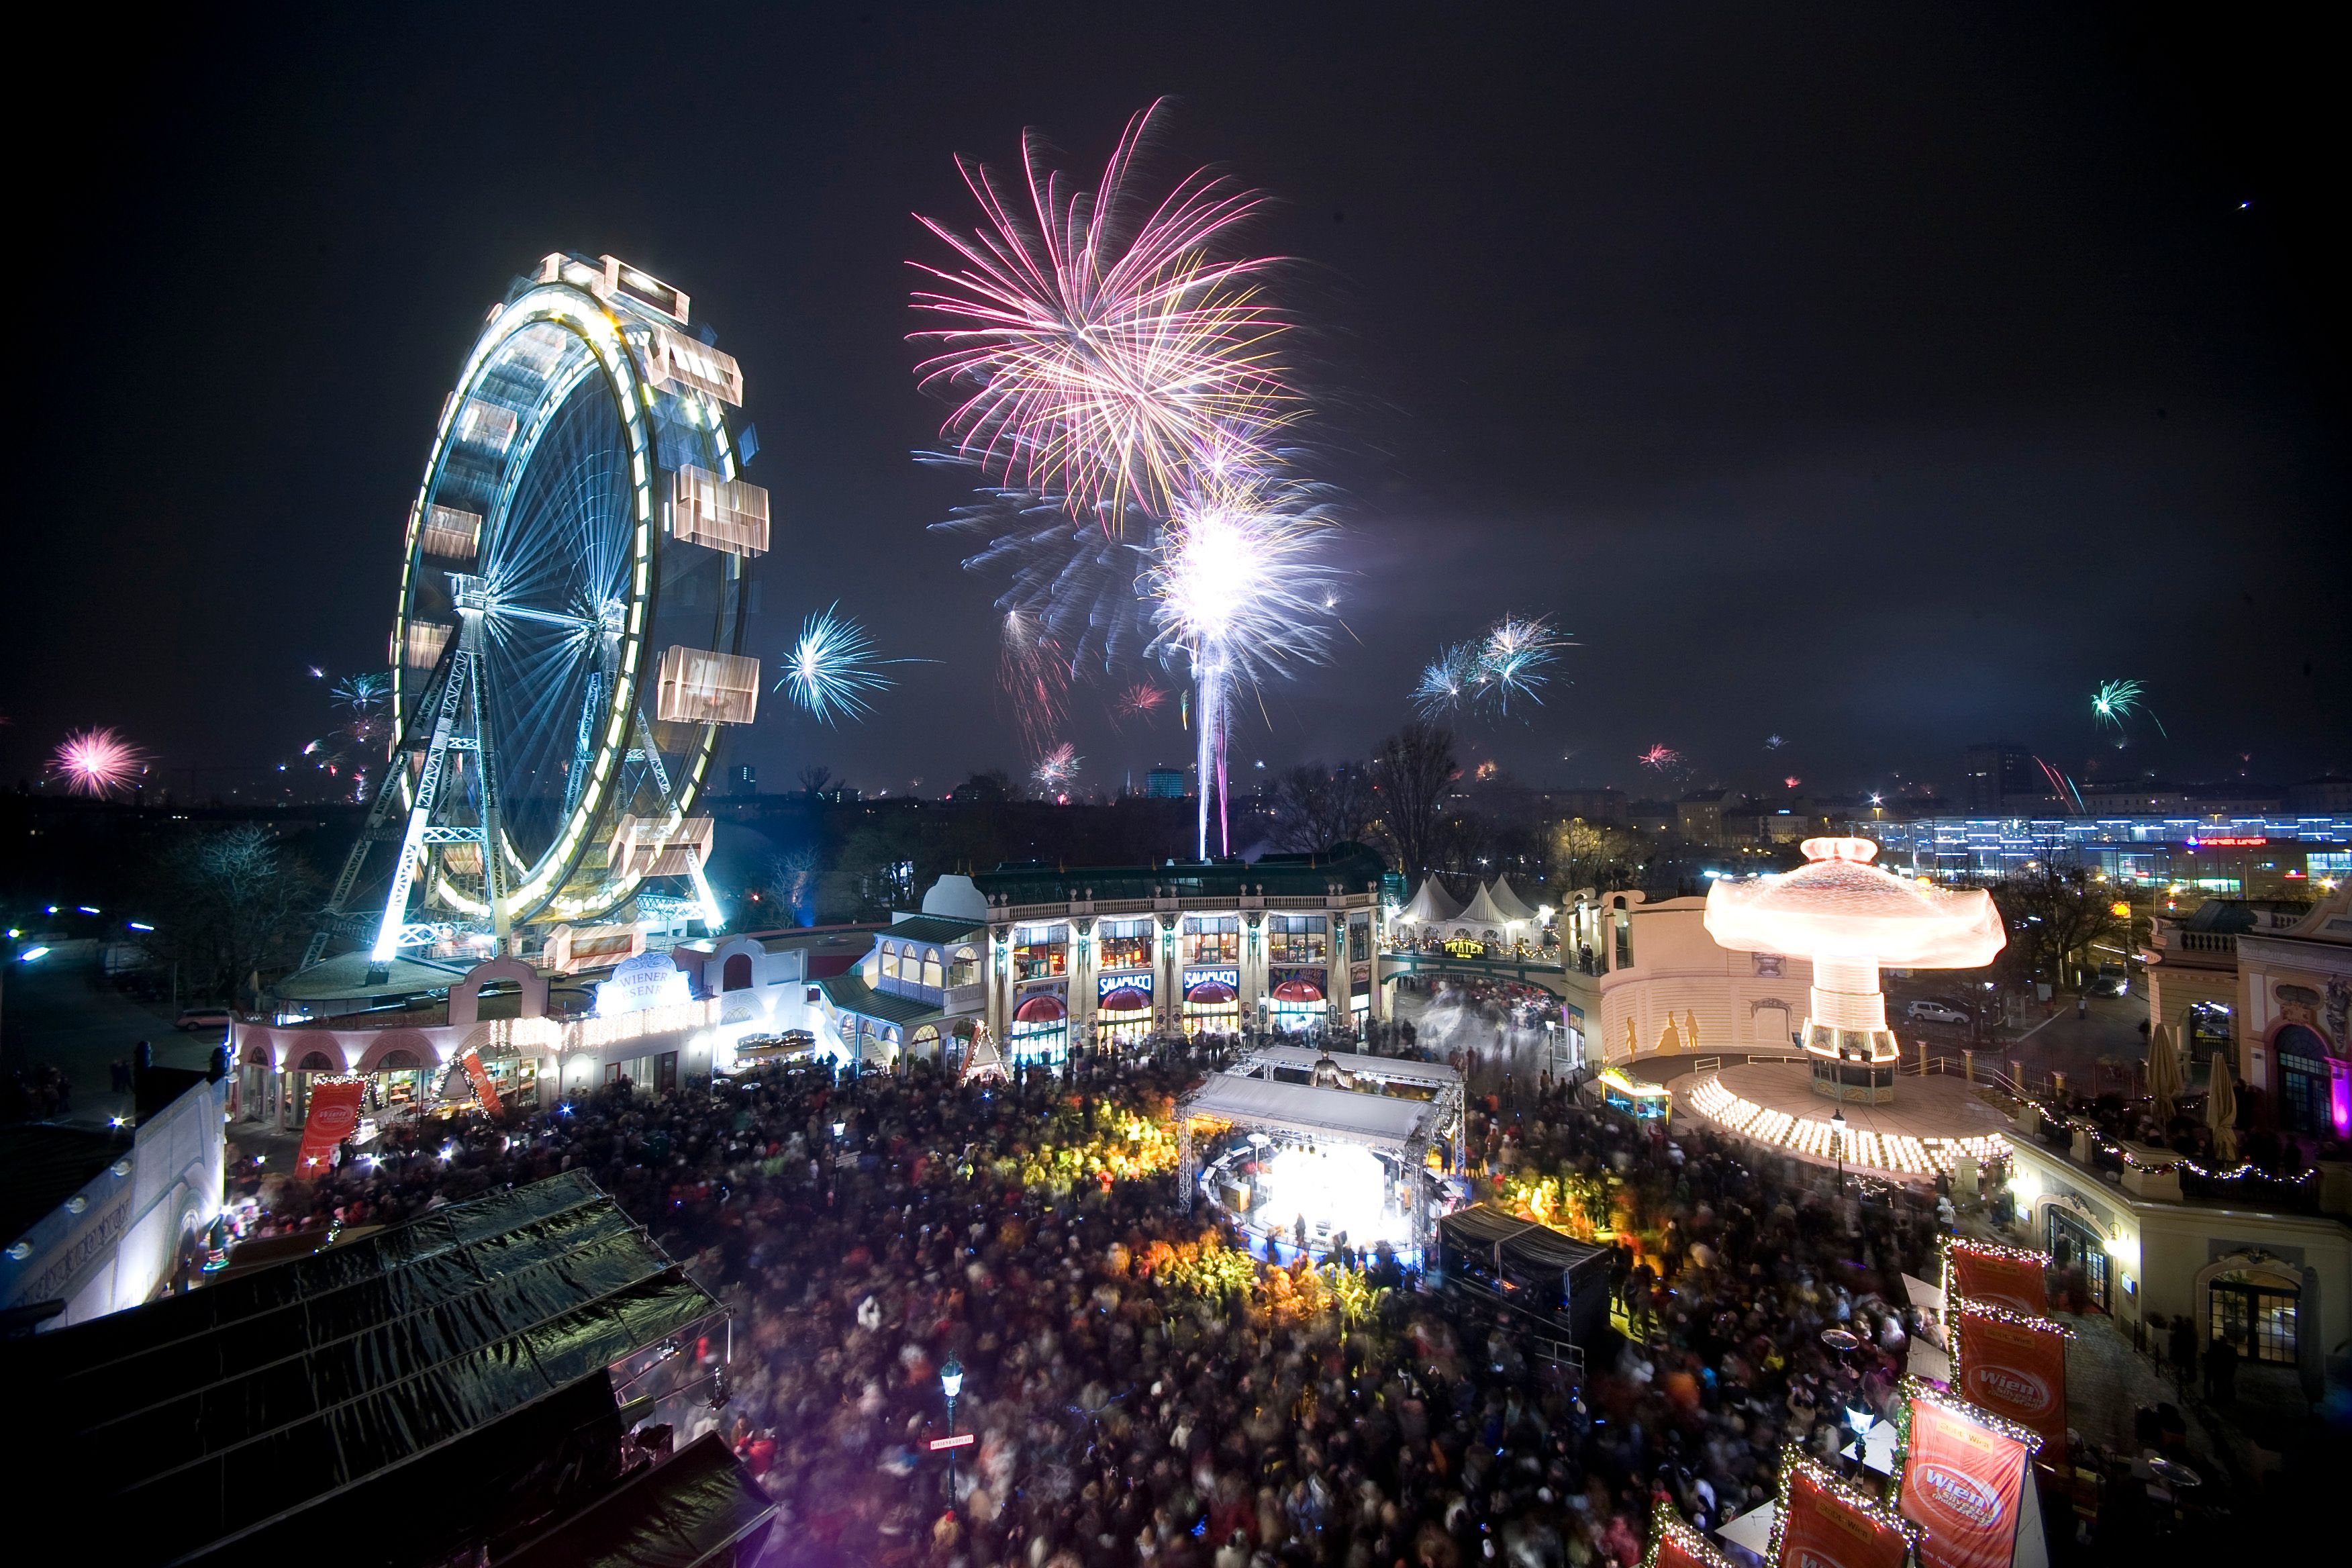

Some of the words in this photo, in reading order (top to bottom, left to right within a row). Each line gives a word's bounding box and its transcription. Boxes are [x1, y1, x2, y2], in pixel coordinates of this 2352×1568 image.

[1444, 941, 1484, 954] PRATER
[620, 972, 668, 987] WIENER
[1099, 975, 1152, 995] SALAMUCCI
[1184, 971, 1237, 989] SALAMUCCI
[1980, 1369, 2035, 1396] Wien
[1926, 1468, 1985, 1508] Wien
[1847, 1518, 1868, 1538] Wien
